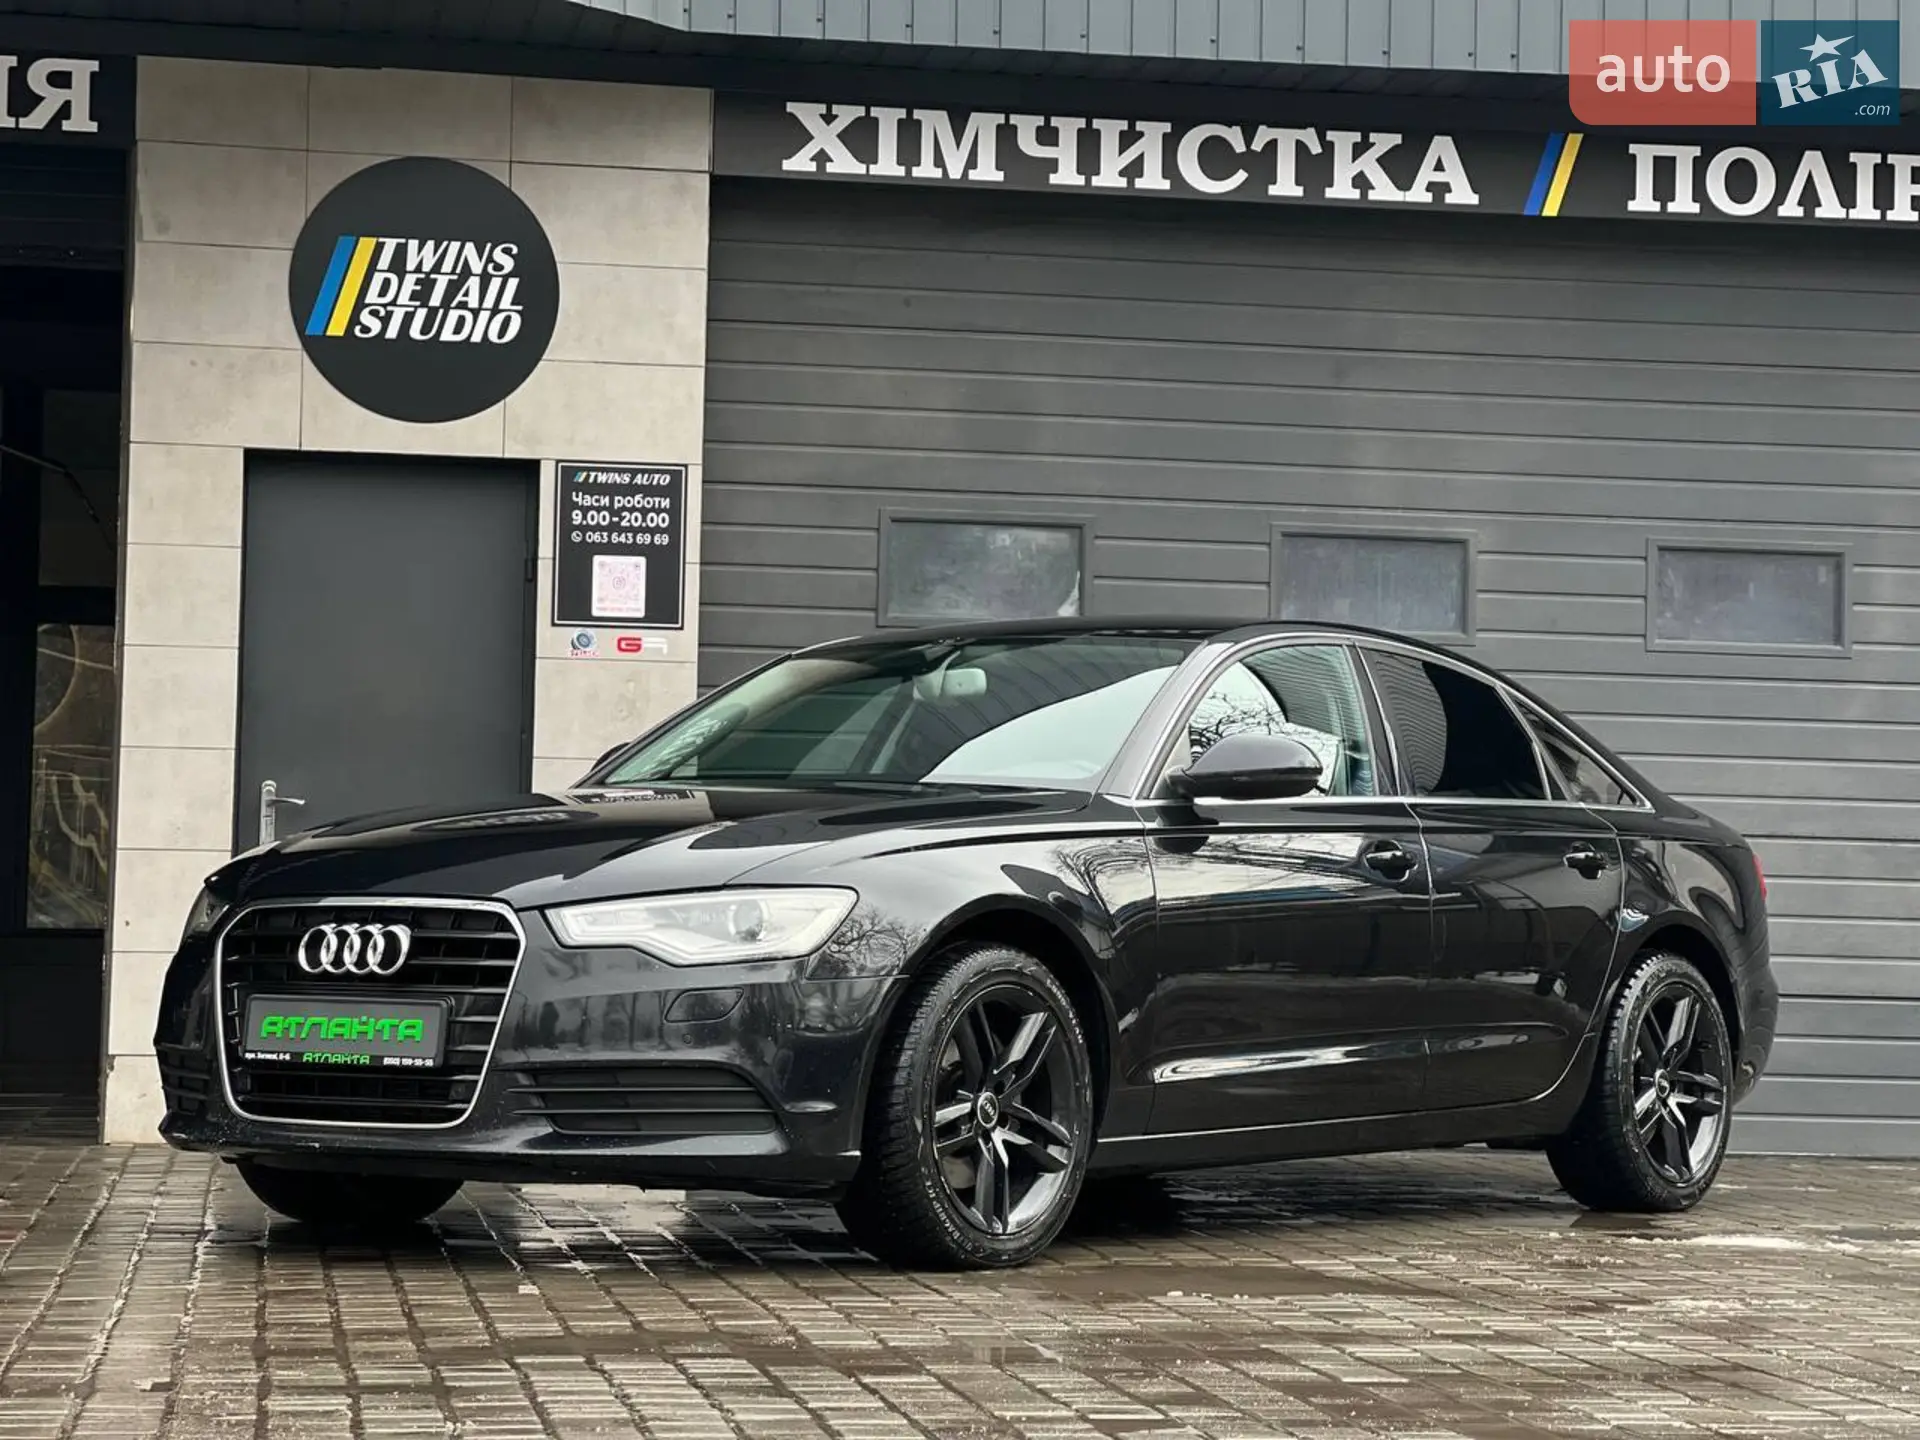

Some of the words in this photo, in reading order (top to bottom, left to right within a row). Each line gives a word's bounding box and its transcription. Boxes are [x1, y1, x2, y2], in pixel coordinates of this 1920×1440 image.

[0, 54, 100, 133] Я
[781, 101, 1480, 206] ХІМЧИСТКА
[375, 237, 519, 276] TWINS
[364, 271, 524, 310] DETAIL
[354, 305, 522, 344] STUDIO
[587, 471, 632, 484] TWINS
[632, 473, 671, 486] AUTO
[572, 491, 610, 507] Часи
[614, 493, 670, 510] роботи
[585, 531, 609, 543] 063
[611, 531, 634, 544] 643
[636, 533, 652, 545] 69
[653, 533, 669, 546] 69
